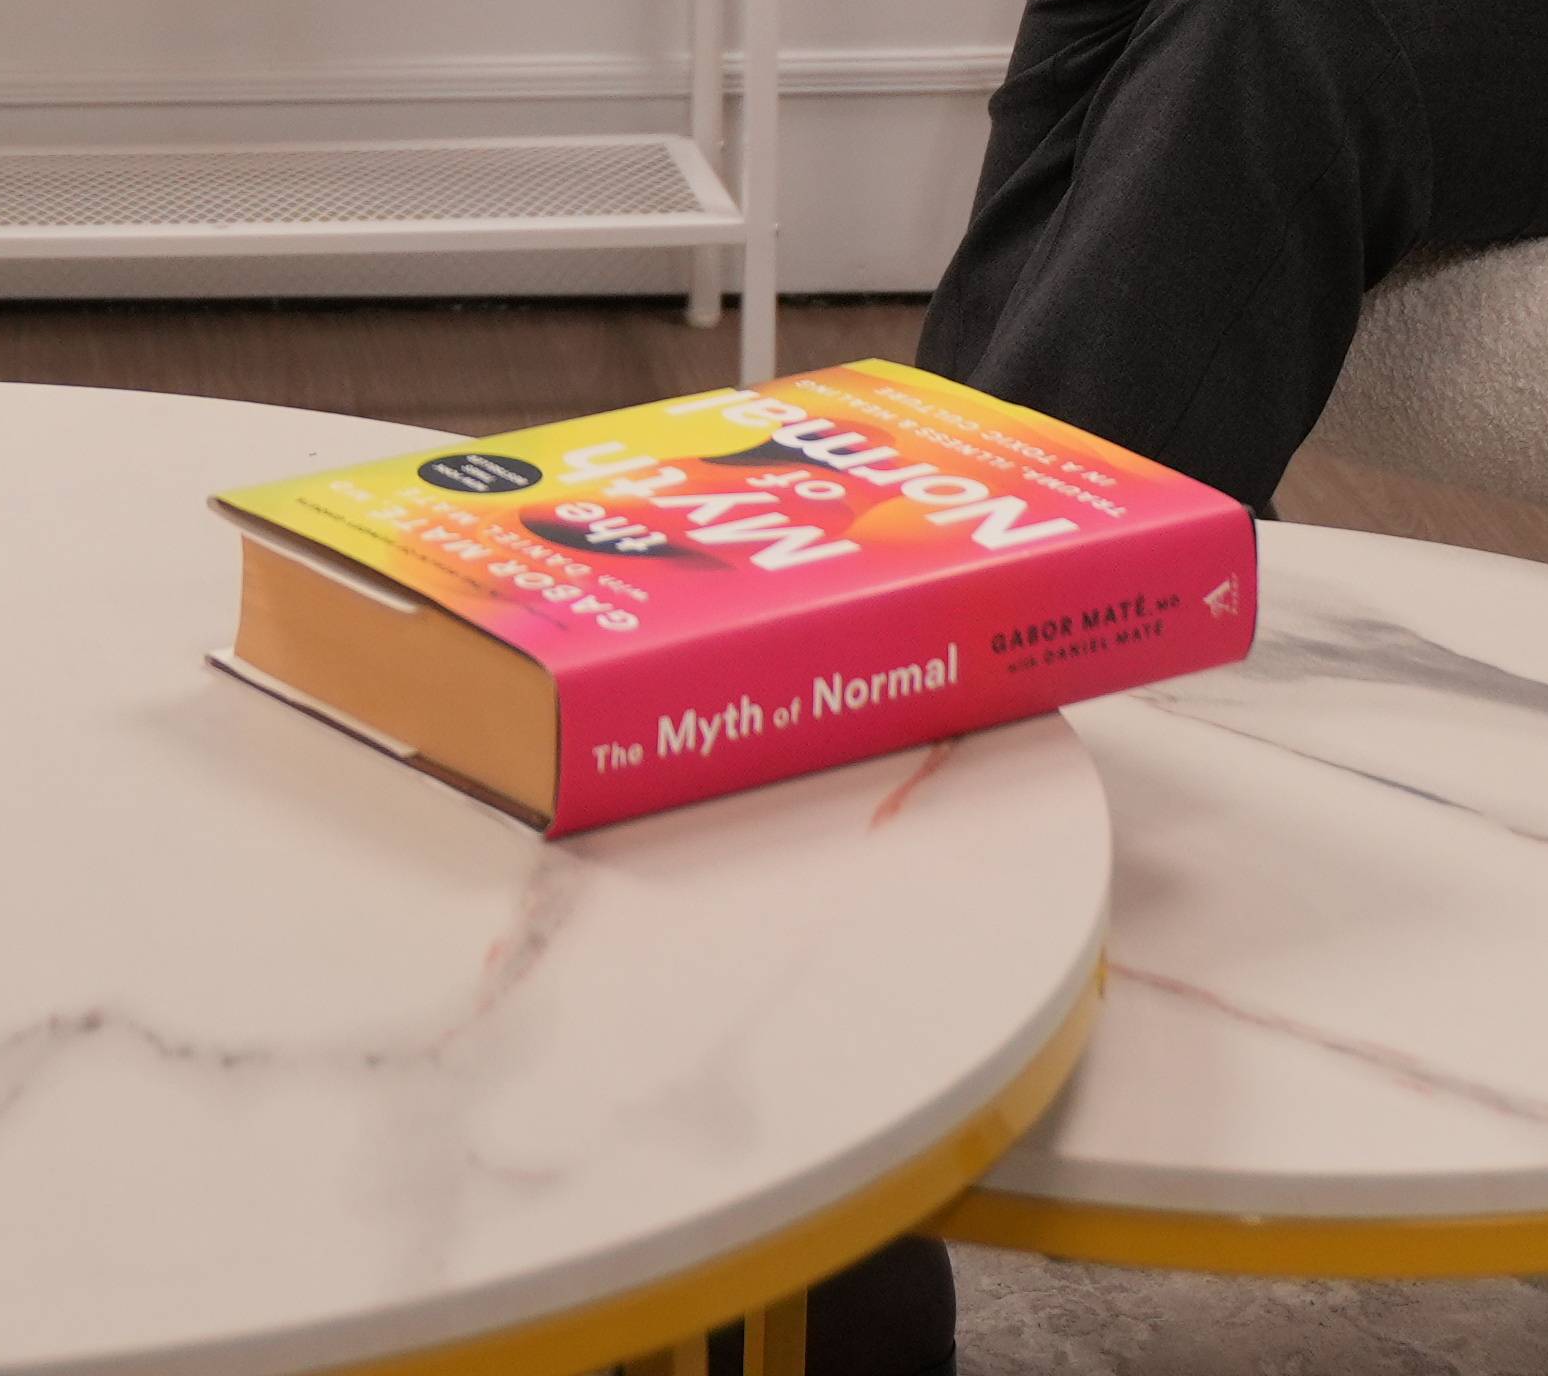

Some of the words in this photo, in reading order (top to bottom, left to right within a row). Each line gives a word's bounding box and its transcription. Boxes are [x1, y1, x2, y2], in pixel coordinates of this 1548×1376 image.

[557, 441, 859, 571] Myth
[664, 389, 1081, 554] Normal
[745, 470, 846, 501] of
[555, 502, 667, 551] the
[487, 559, 640, 632] GABOR
[991, 616, 1073, 654] GABOR
[592, 741, 644, 773] The
[657, 695, 764, 758] Myth
[773, 696, 801, 729] of
[812, 642, 958, 718] Normal
